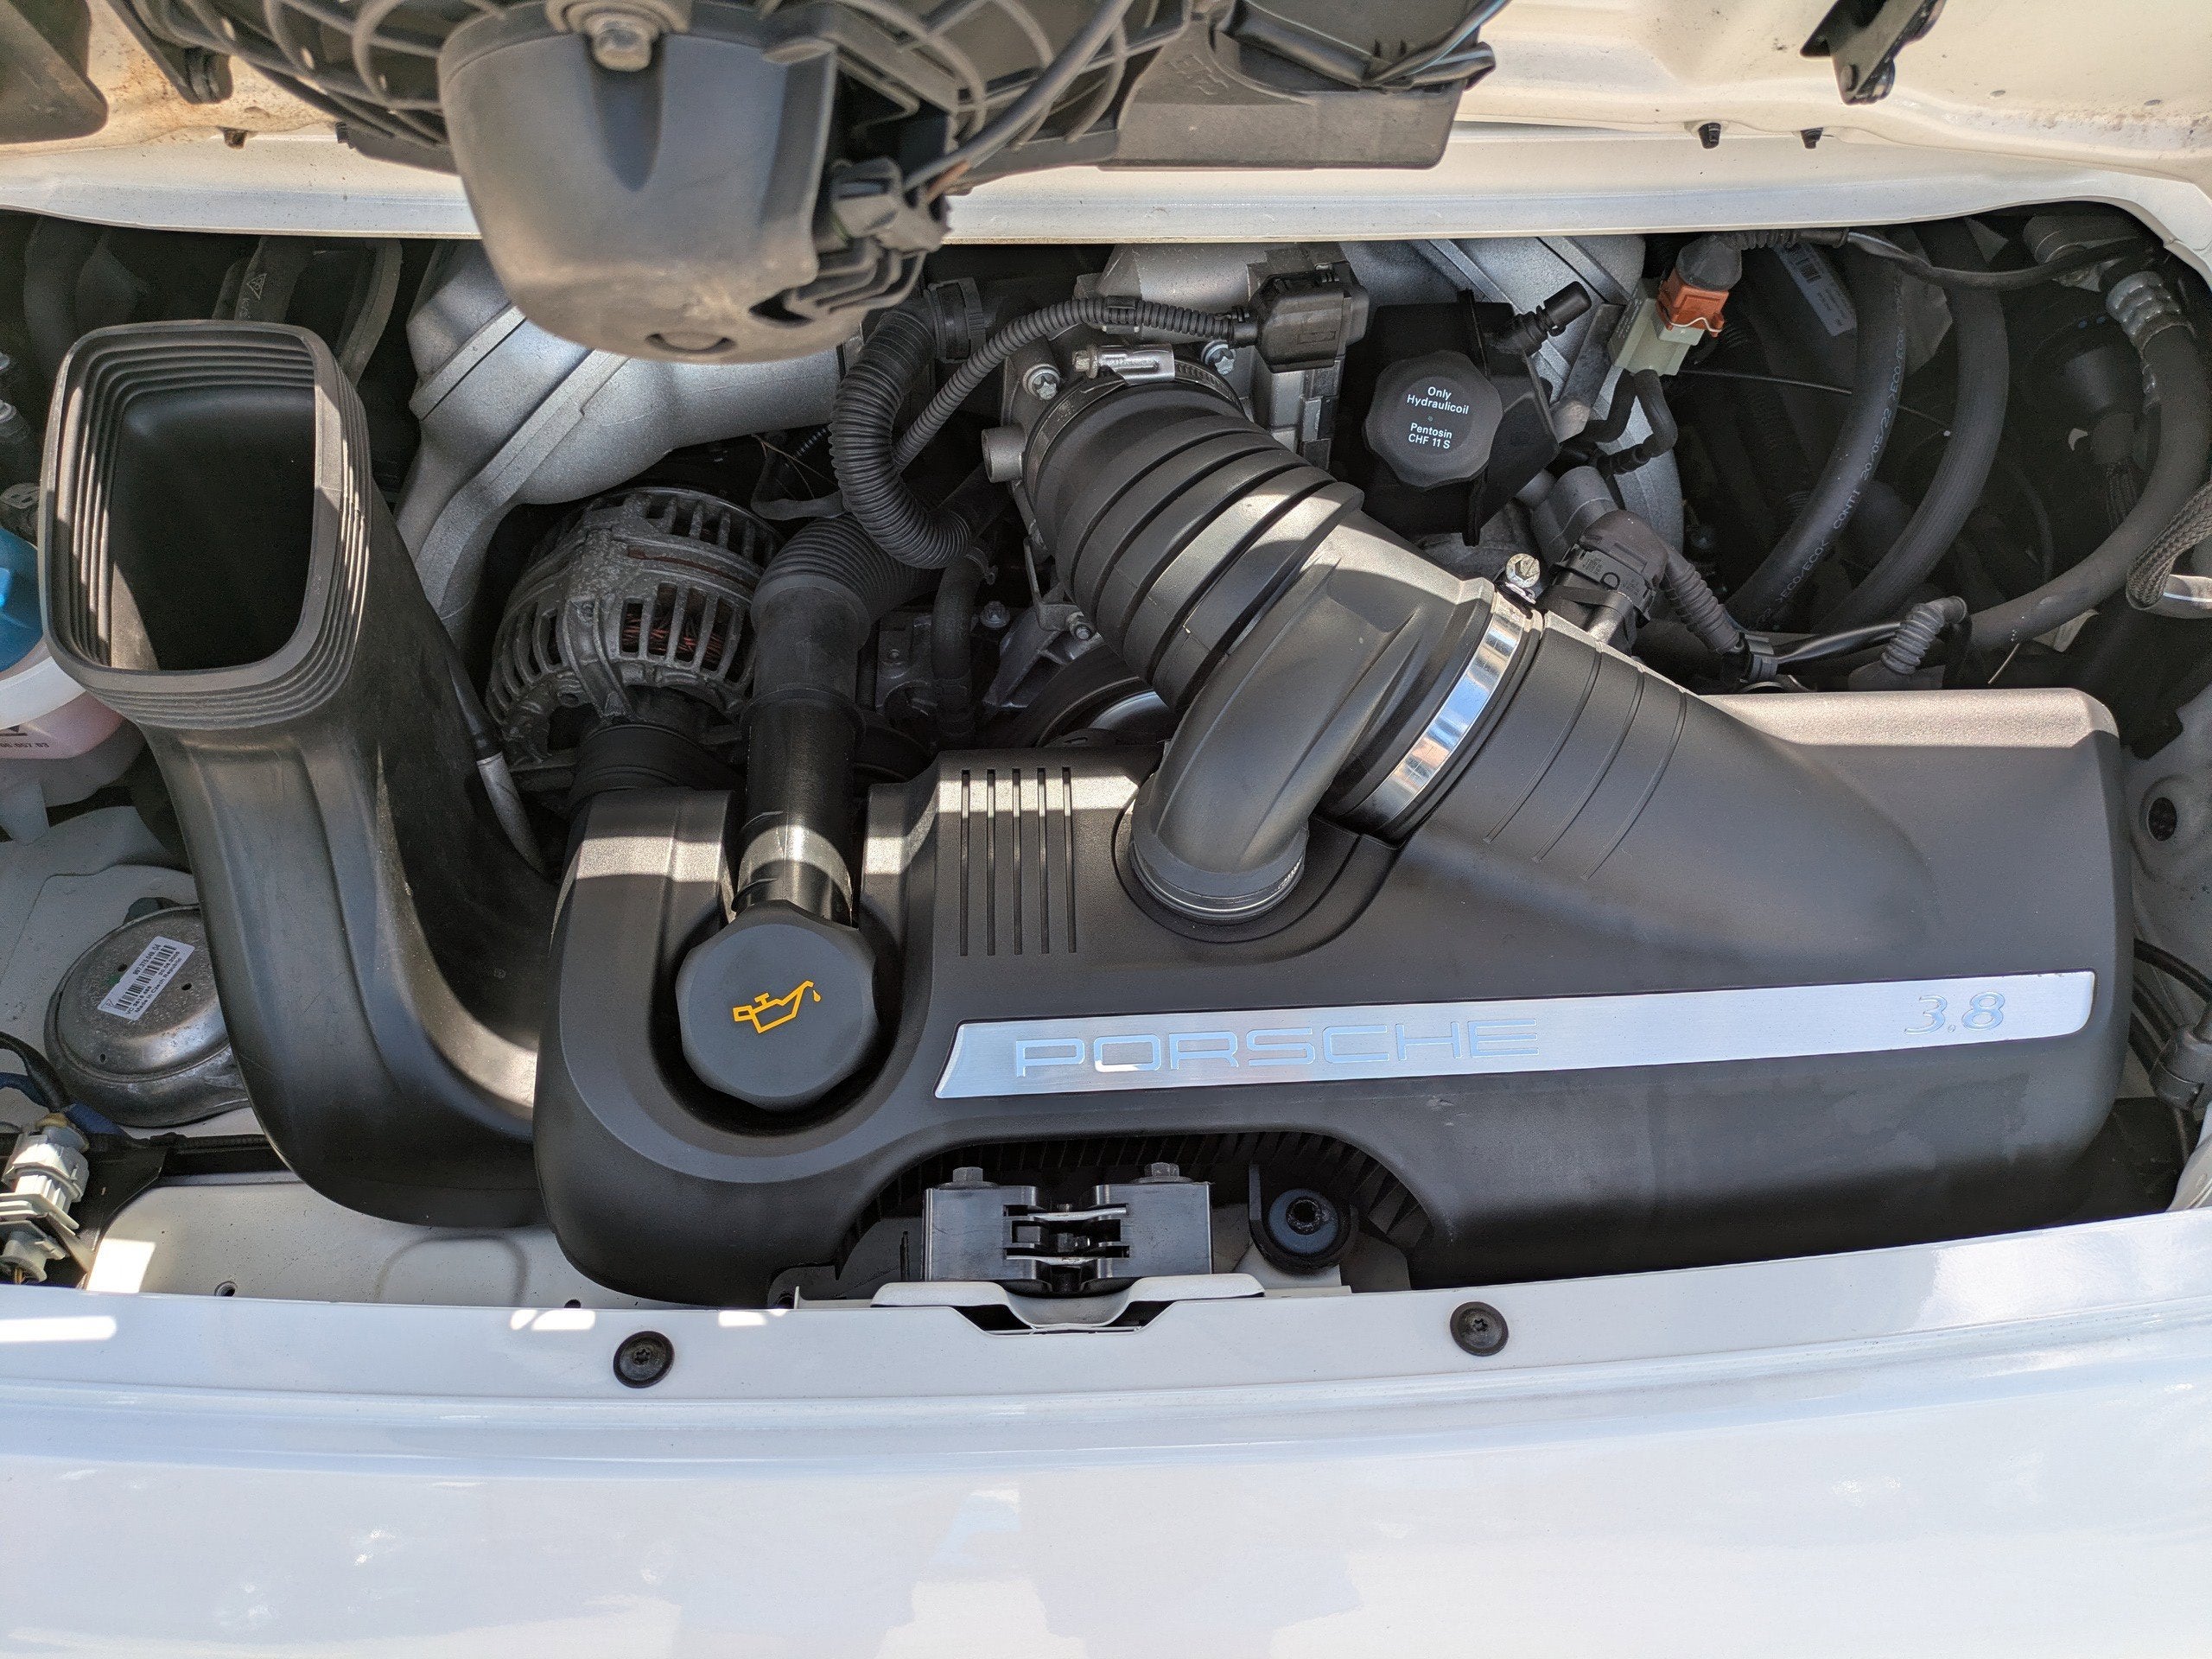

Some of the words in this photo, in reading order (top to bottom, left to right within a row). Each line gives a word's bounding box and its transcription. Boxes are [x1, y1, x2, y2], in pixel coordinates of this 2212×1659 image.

[1407, 394, 1469, 415] Hydraulicoil
[1427, 386, 1452, 401] Only
[1408, 434, 1429, 445] CHF
[1432, 438, 1441, 448] 11
[1443, 440, 1451, 449] S
[1410, 423, 1452, 439] Pentosin
[1833, 489, 1860, 529] CONTI
[135, 1000, 149, 1013] Made
[151, 978, 165, 994] Czech
[163, 958, 181, 978] Republic
[1904, 992, 2005, 1034] 3.8
[1015, 1018, 1539, 1077] PORSCHE
